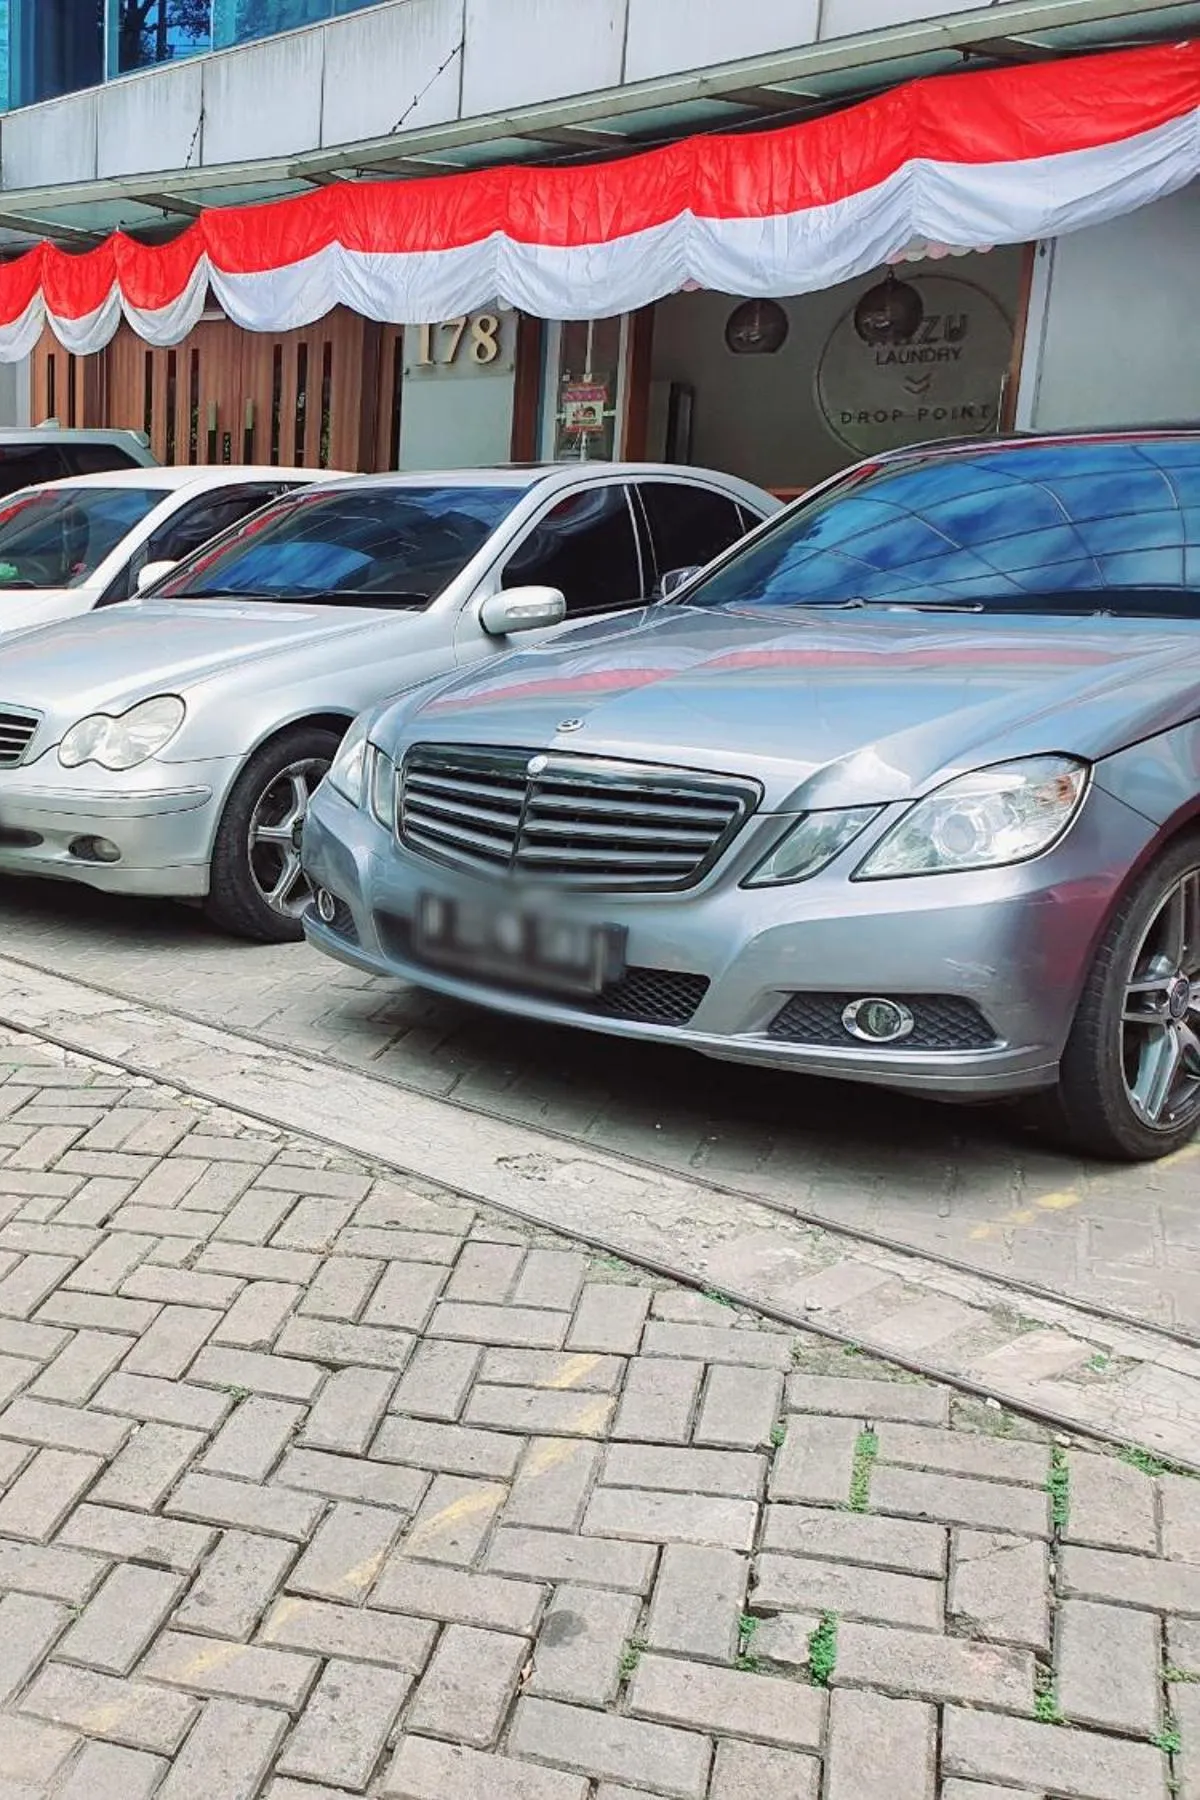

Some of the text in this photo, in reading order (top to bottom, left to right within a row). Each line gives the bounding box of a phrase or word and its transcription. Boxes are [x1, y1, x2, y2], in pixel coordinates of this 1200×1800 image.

[416, 315, 498, 366] 178
[875, 347, 962, 365] LAUNDRY
[841, 404, 990, 424] DROP POINT
